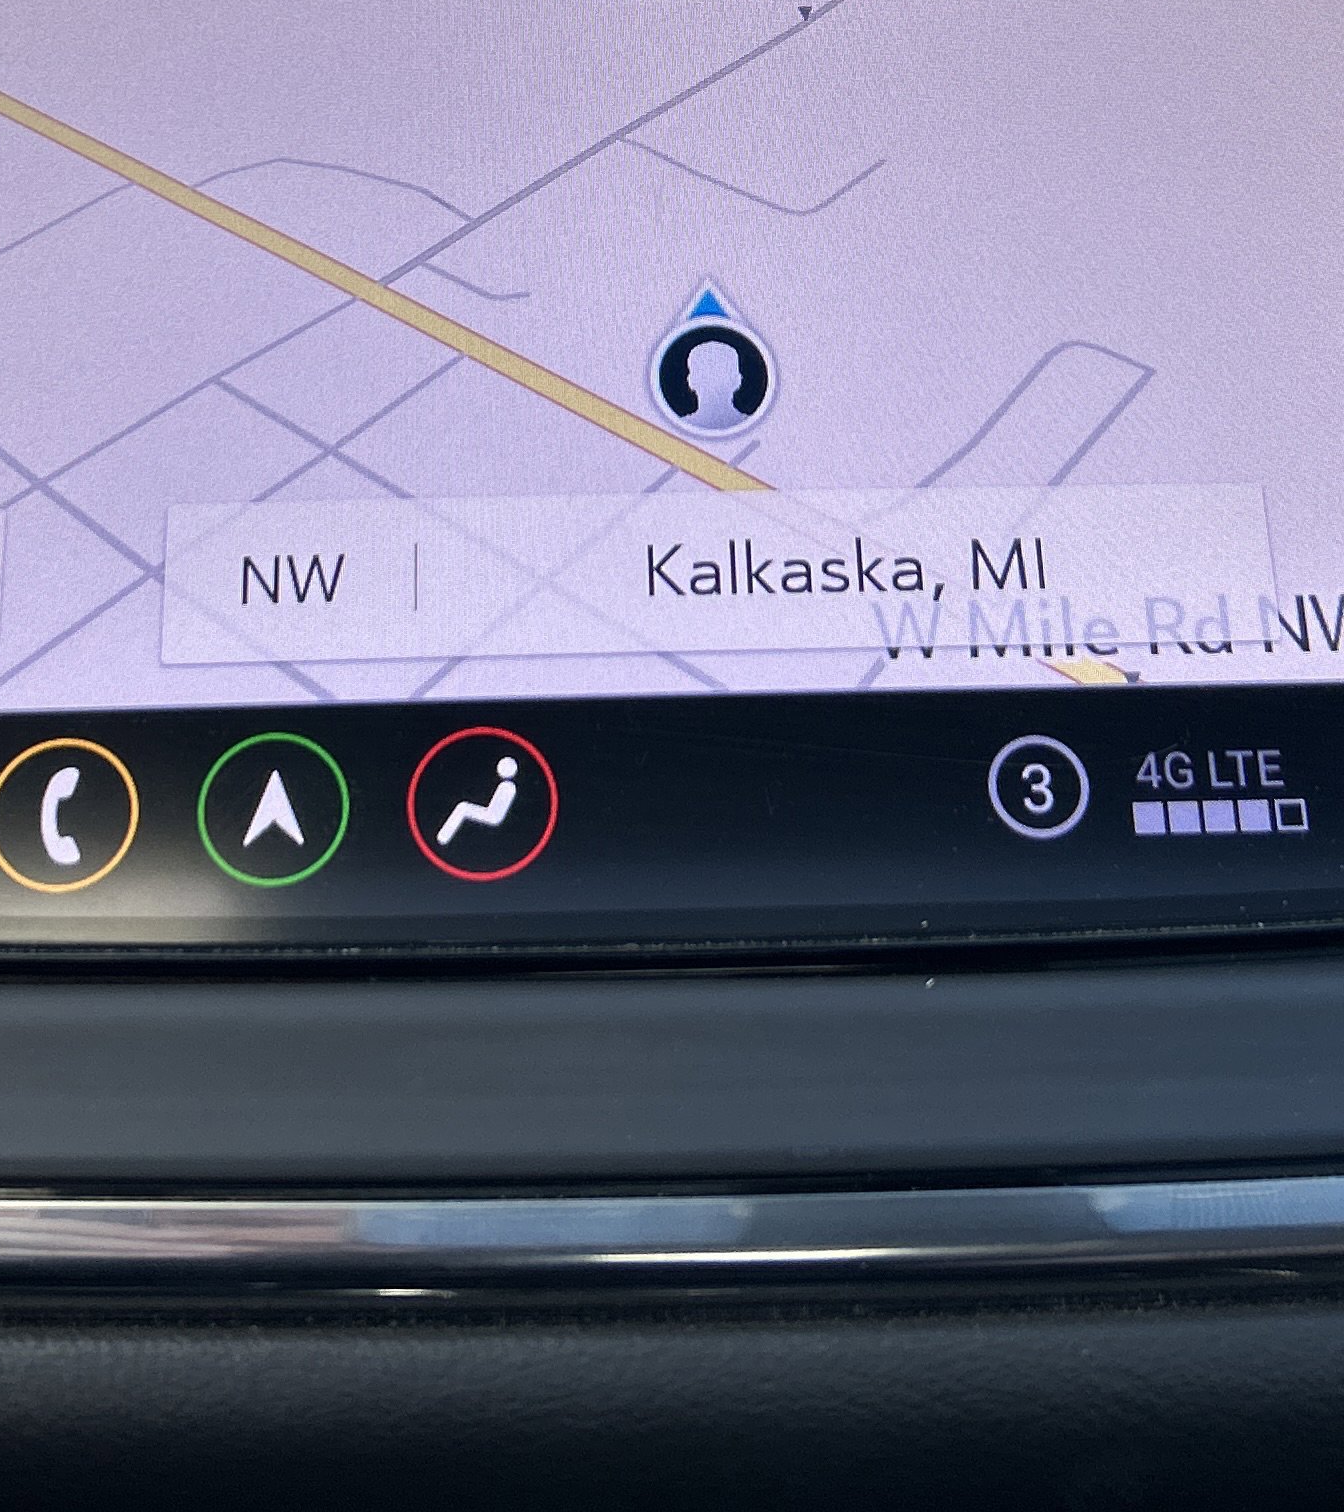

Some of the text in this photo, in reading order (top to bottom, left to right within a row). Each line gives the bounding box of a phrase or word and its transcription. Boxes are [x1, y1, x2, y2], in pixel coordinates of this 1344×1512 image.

[240, 553, 346, 604] NW
[646, 538, 1047, 600] Kalkaska, MI
[875, 603, 936, 658] W
[966, 598, 1120, 656] Mile
[1150, 596, 1236, 654] Rd
[1021, 764, 1055, 813] 3
[1136, 750, 1283, 790] 4G LTE
